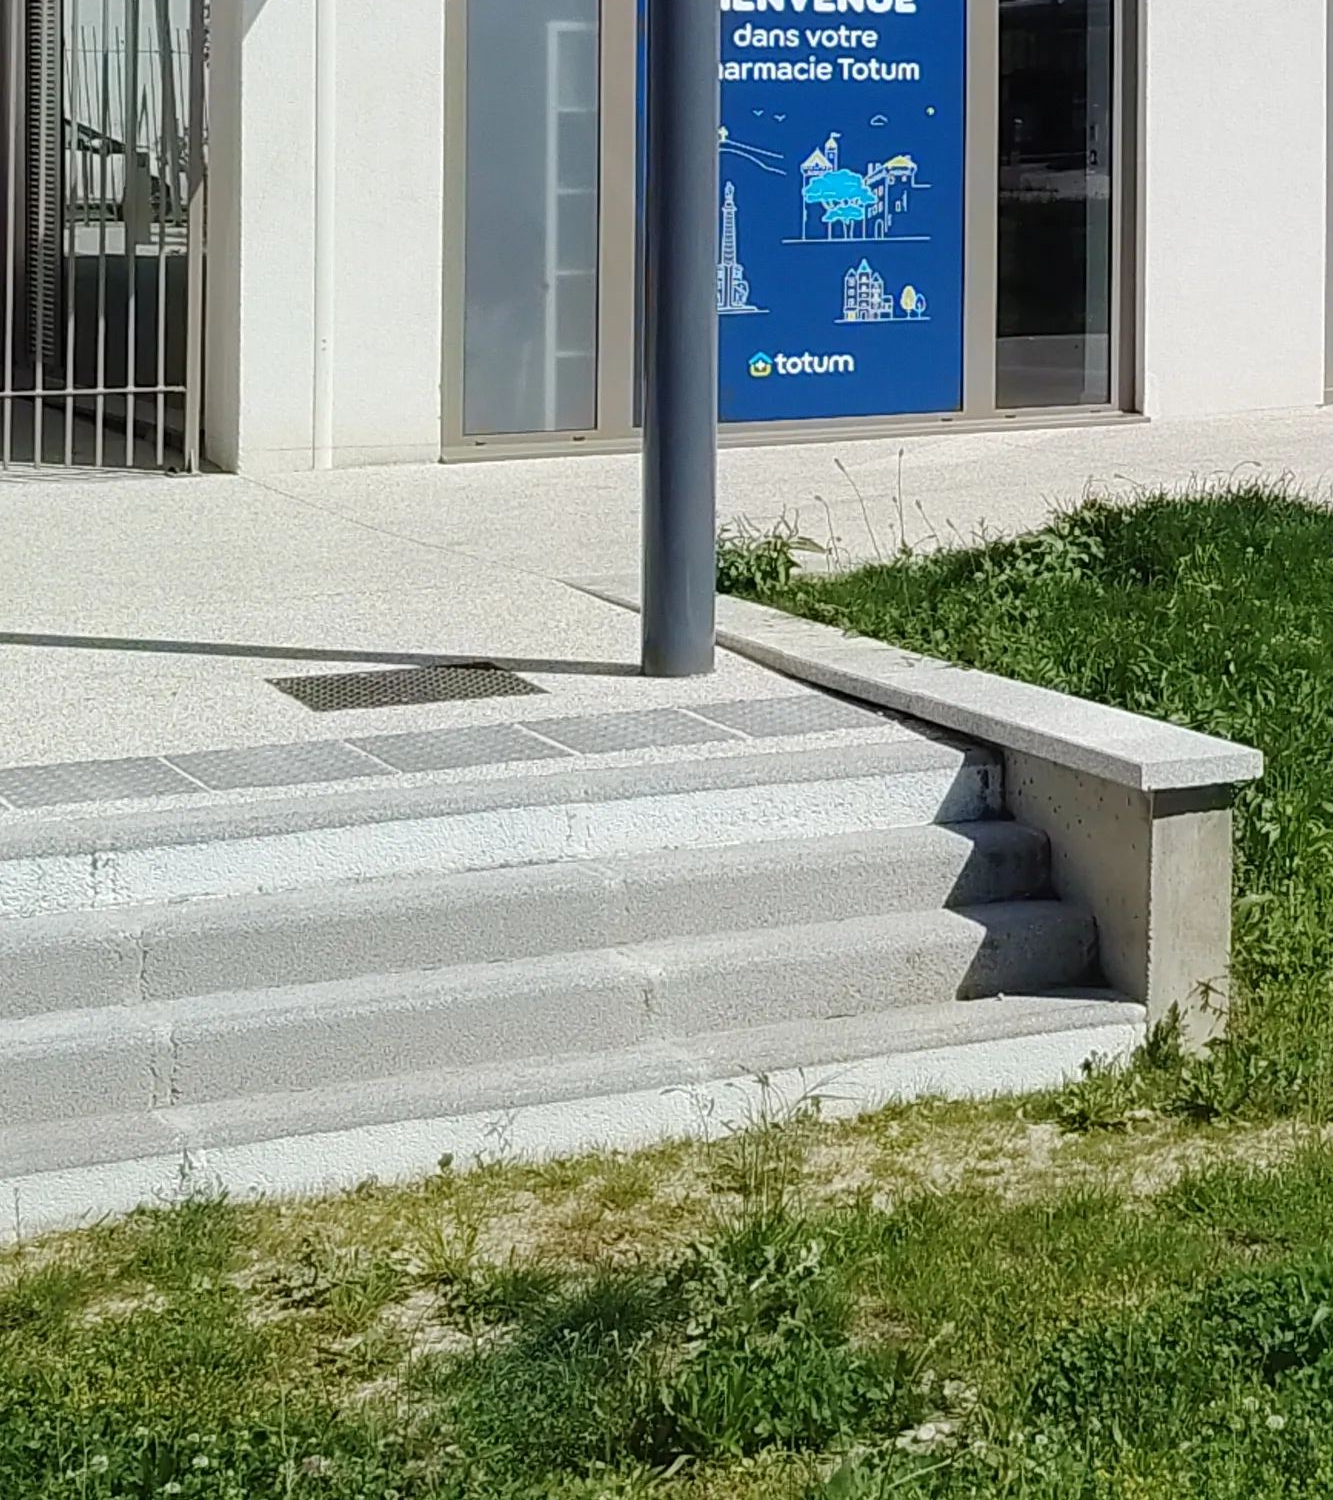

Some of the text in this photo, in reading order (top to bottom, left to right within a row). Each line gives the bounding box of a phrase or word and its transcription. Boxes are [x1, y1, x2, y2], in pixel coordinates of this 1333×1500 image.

[733, 23, 878, 48] dans votre
[717, 55, 920, 81] armacie Totum
[774, 351, 855, 375] totum
